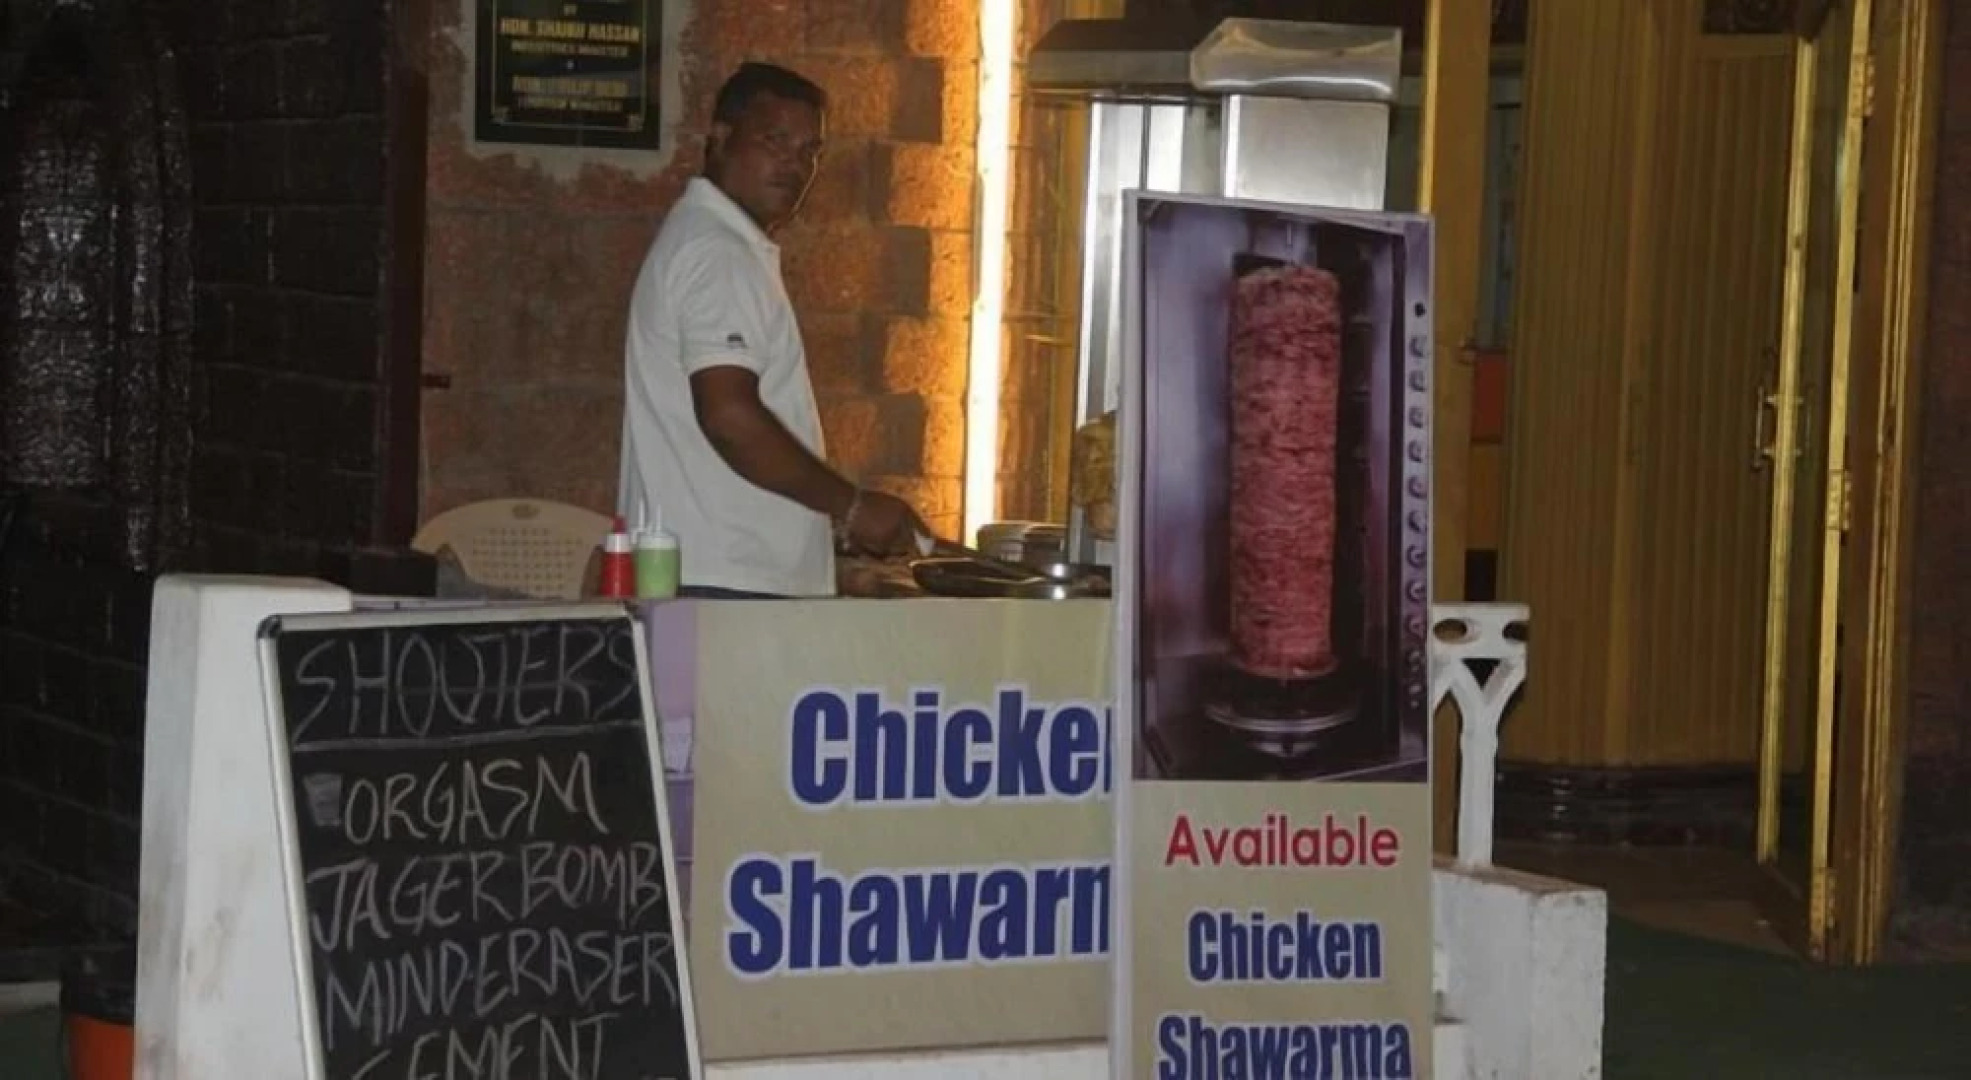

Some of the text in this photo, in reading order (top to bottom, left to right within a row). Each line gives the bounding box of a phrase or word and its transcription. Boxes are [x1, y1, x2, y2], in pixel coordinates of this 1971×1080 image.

[791, 691, 1111, 803] Chicke
[346, 752, 609, 844] ORGASM
[1165, 815, 1399, 867] Available
[1188, 911, 1381, 981] Chicken
[1158, 1015, 1412, 1080] Shawarma
